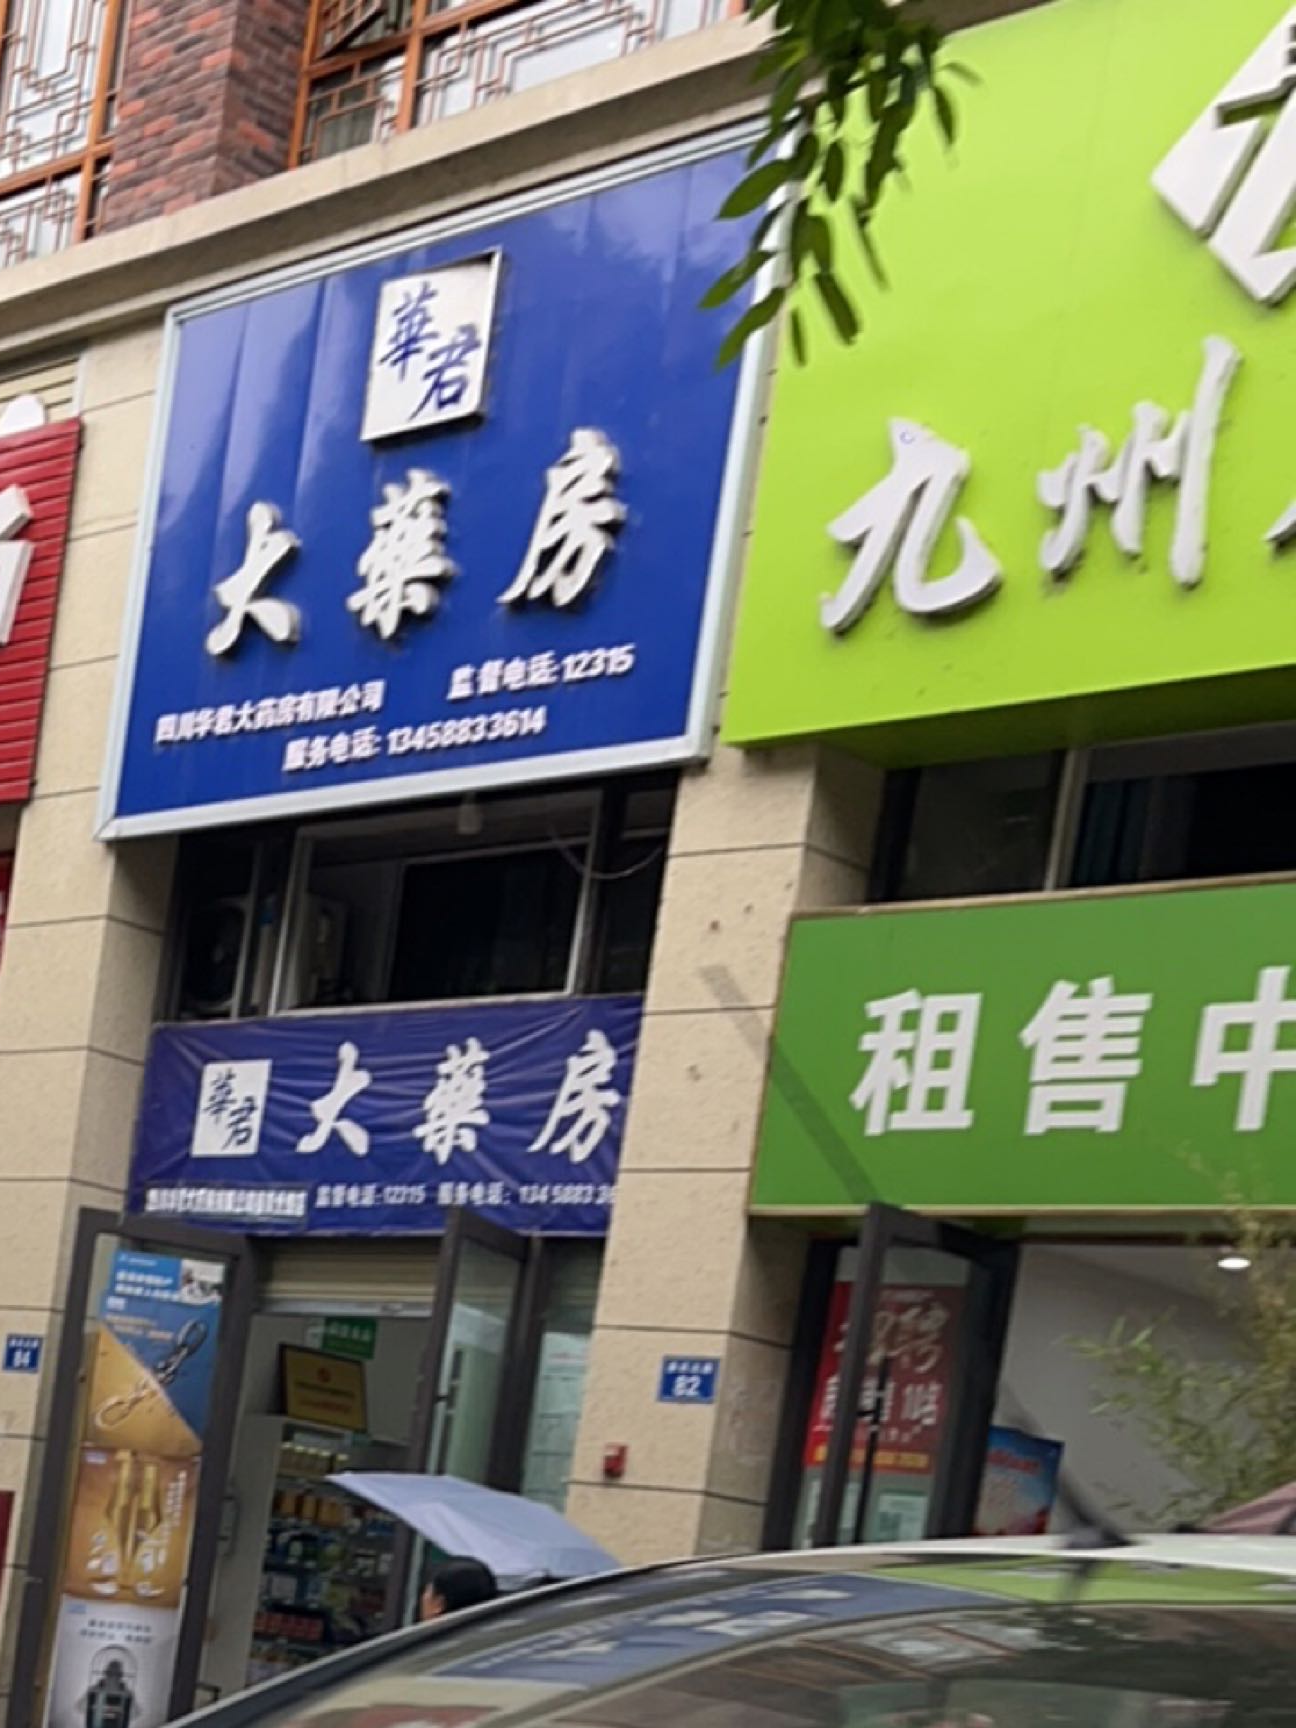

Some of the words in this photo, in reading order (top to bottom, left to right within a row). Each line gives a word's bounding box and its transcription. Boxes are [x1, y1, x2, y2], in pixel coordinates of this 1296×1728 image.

[820, 334, 1296, 636] 九州
[849, 965, 1296, 1137] 租售中
